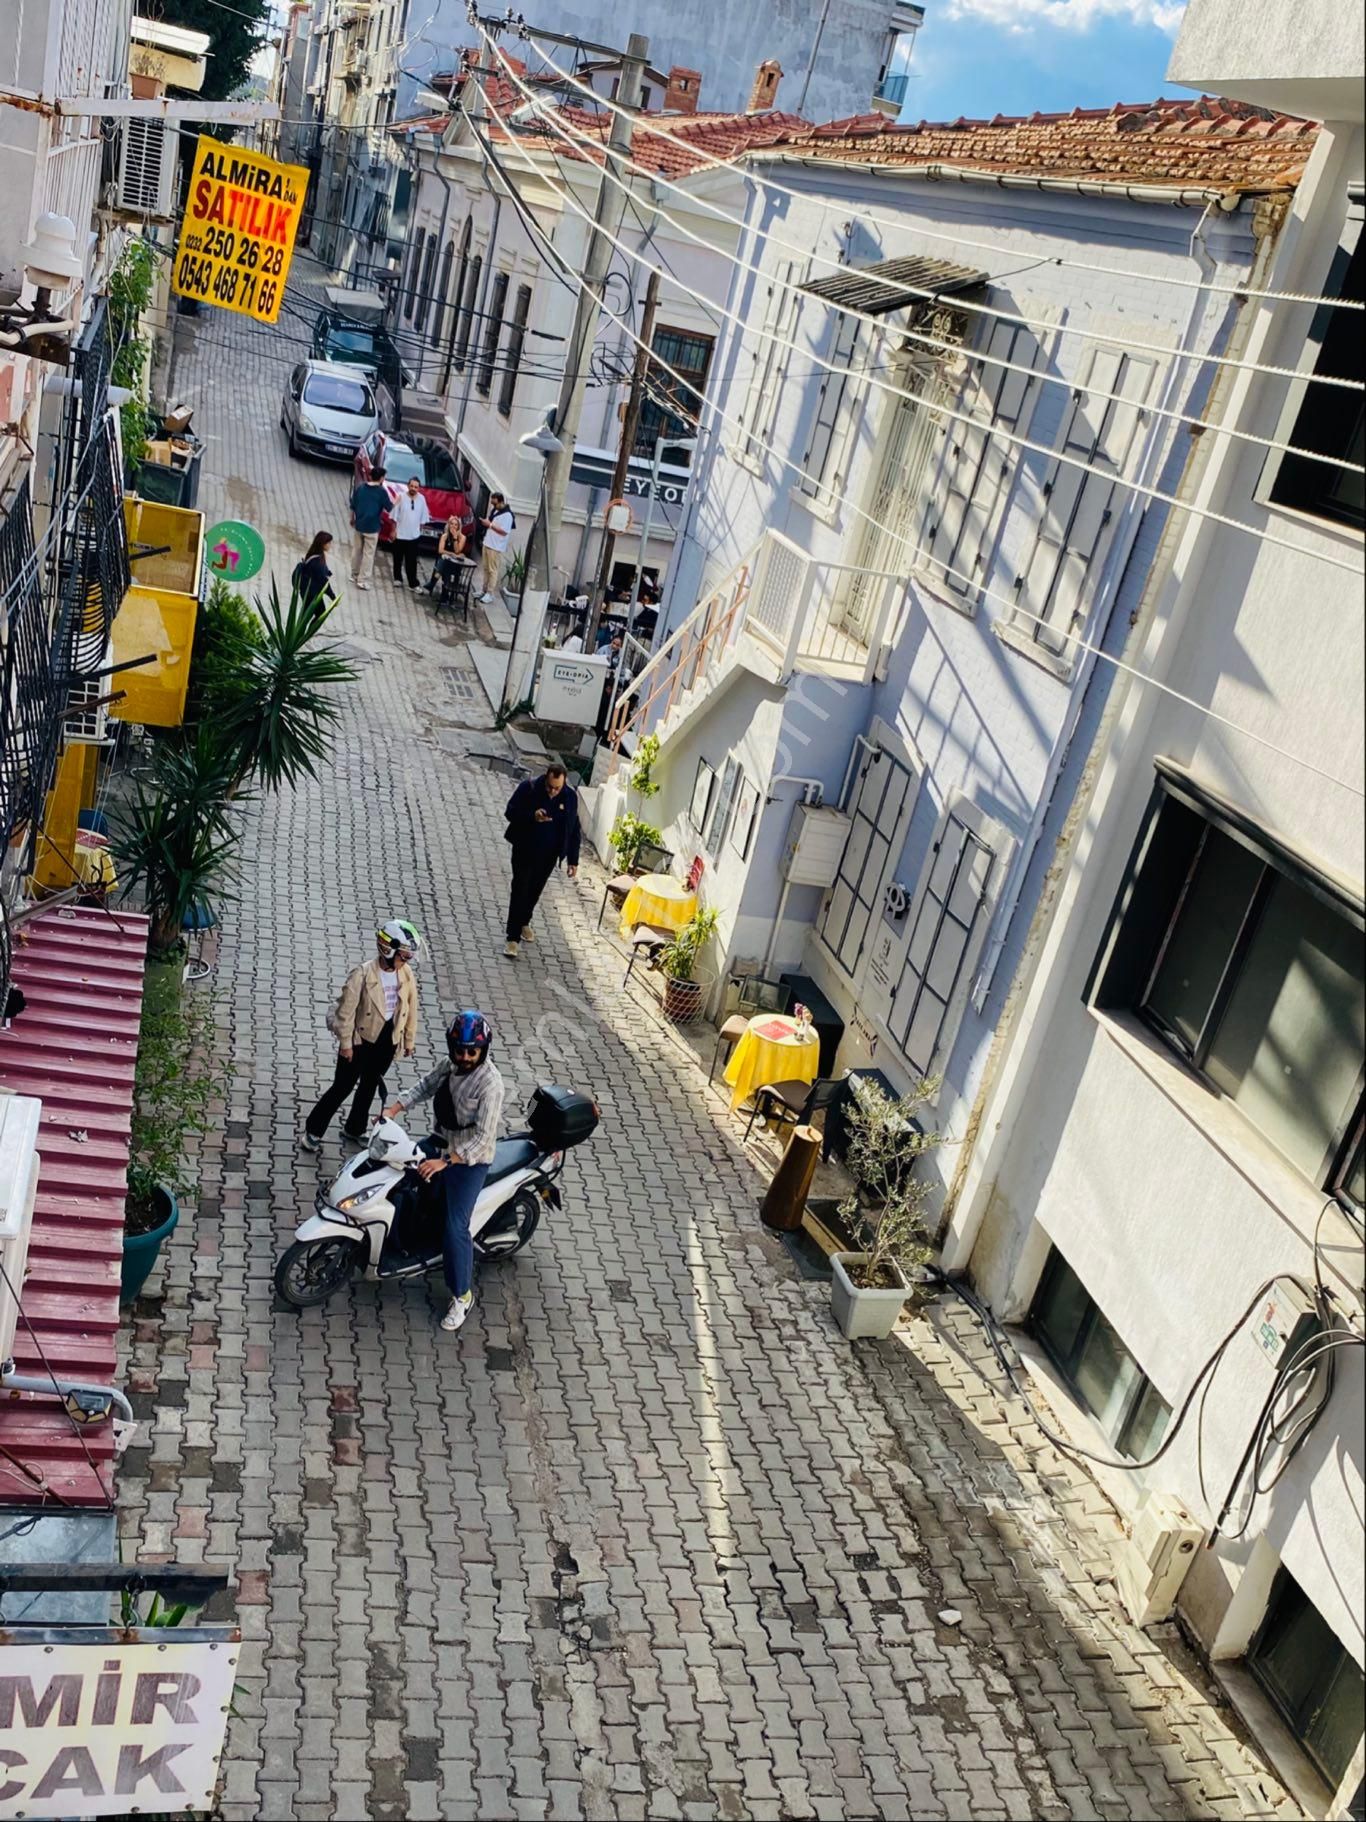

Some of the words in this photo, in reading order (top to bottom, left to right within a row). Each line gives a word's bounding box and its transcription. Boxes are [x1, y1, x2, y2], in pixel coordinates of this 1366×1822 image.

[193, 180, 293, 245] SATILIK
[203, 226, 235, 261] 250
[236, 238, 260, 269] 26
[261, 248, 284, 277] 28
[178, 253, 213, 296] 0543
[213, 265, 239, 304] 468
[239, 273, 257, 309] 71
[257, 279, 277, 315] 66
